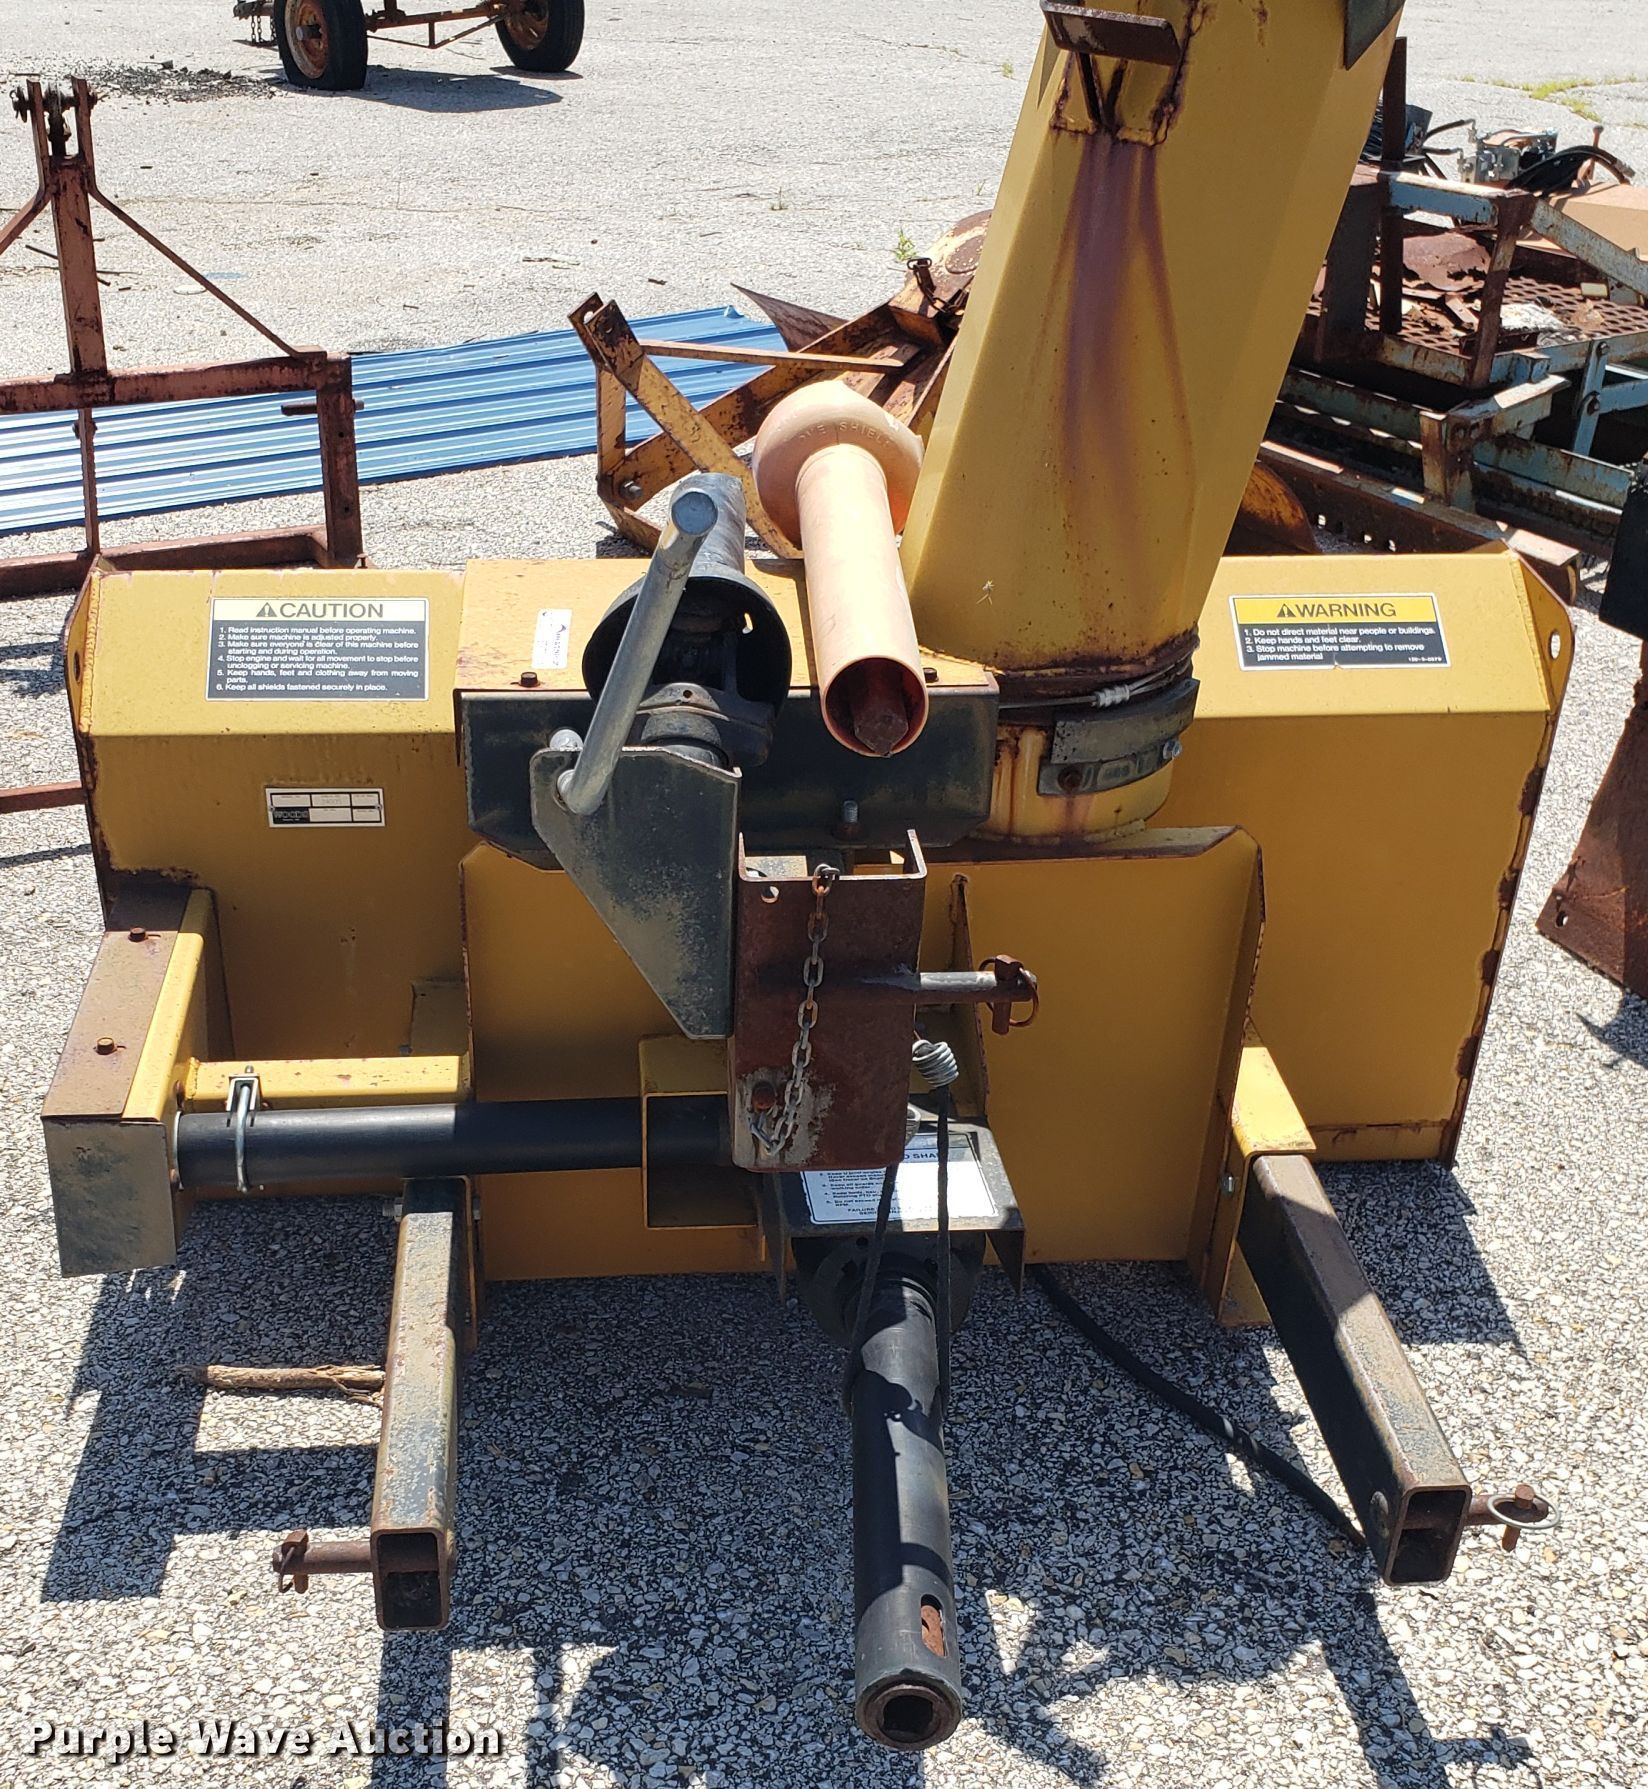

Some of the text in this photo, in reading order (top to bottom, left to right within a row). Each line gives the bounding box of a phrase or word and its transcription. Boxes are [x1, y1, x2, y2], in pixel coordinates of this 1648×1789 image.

[280, 603, 383, 618] CAUTION
[1295, 603, 1397, 617] WARNING
[382, 627, 416, 635] machine.
[1266, 628, 1280, 636] not
[1281, 628, 1305, 636] direct
[1359, 627, 1387, 636] people
[1398, 626, 1436, 635] buildings.
[311, 634, 344, 642] adjusted
[345, 635, 379, 643] properly.
[1254, 637, 1277, 645] Keep
[1277, 636, 1303, 644] hands
[1304, 636, 1320, 644] and
[1321, 635, 1338, 643] feet
[1338, 635, 1361, 643] clear.
[269, 642, 305, 650] everyone
[360, 641, 393, 649] machine
[393, 641, 419, 649] before
[1255, 645, 1276, 653] Stop
[1276, 644, 1312, 652] machine
[1340, 643, 1383, 652] attempting
[226, 655, 245, 663] Stop
[393, 655, 419, 663] before
[1256, 652, 1324, 662] jammed material
[227, 669, 249, 677] Keep
[250, 669, 277, 677] hands,
[315, 669, 346, 677] clothing
[391, 670, 419, 678] moving
[225, 684, 247, 692] Keep
[247, 683, 257, 691] all
[257, 683, 286, 691] shields
[286, 683, 321, 691] fastened
[321, 684, 355, 692] securely
[364, 683, 389, 691] place.
